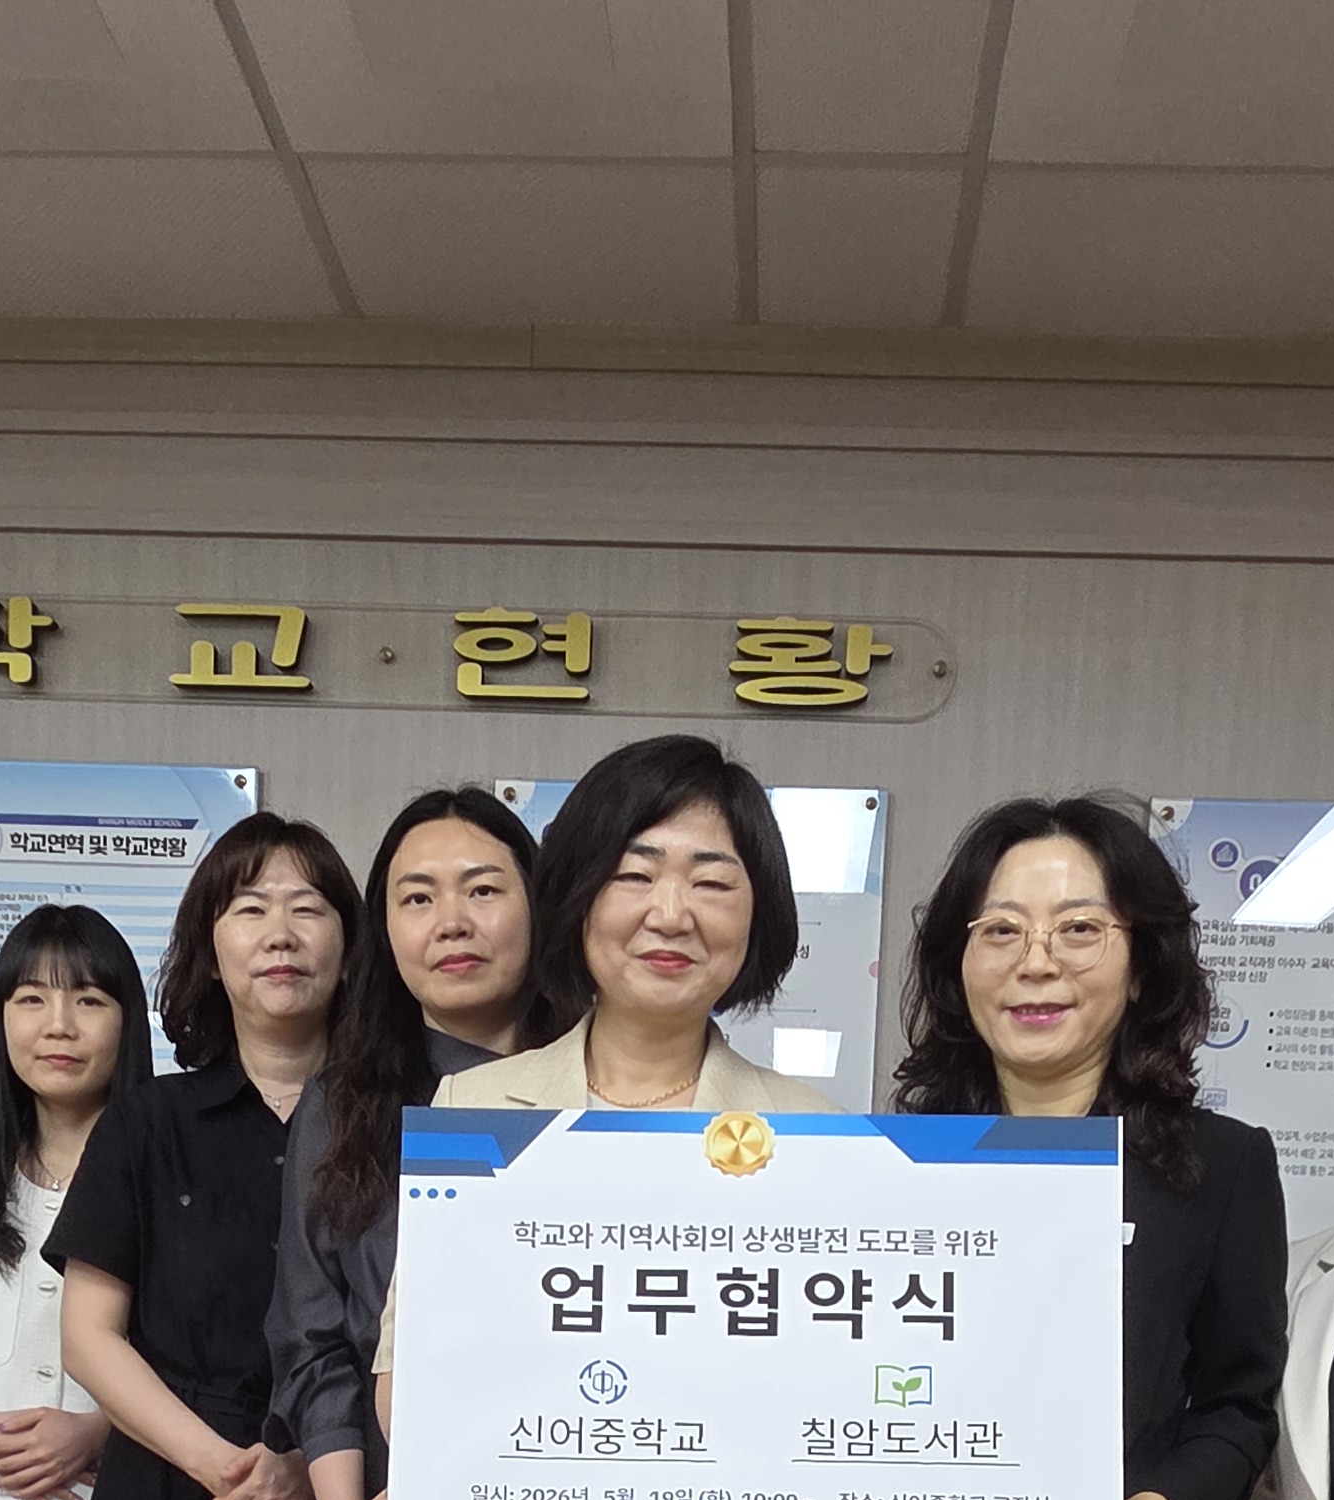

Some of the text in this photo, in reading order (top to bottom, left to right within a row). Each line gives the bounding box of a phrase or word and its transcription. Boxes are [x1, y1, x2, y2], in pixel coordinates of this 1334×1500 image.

[9, 832, 188, 858] 학교연혁 및 학교현황
[1201, 934, 1276, 947] 교육실습 기회제공
[1278, 957, 1306, 968] 이수자
[513, 1221, 999, 1257] 학교와 지역사회의 상생발전 도모를 위한
[541, 1264, 957, 1342] 업무협약식
[509, 1415, 708, 1455] 신어중학교
[801, 1418, 1003, 1459] 칠암도서관
